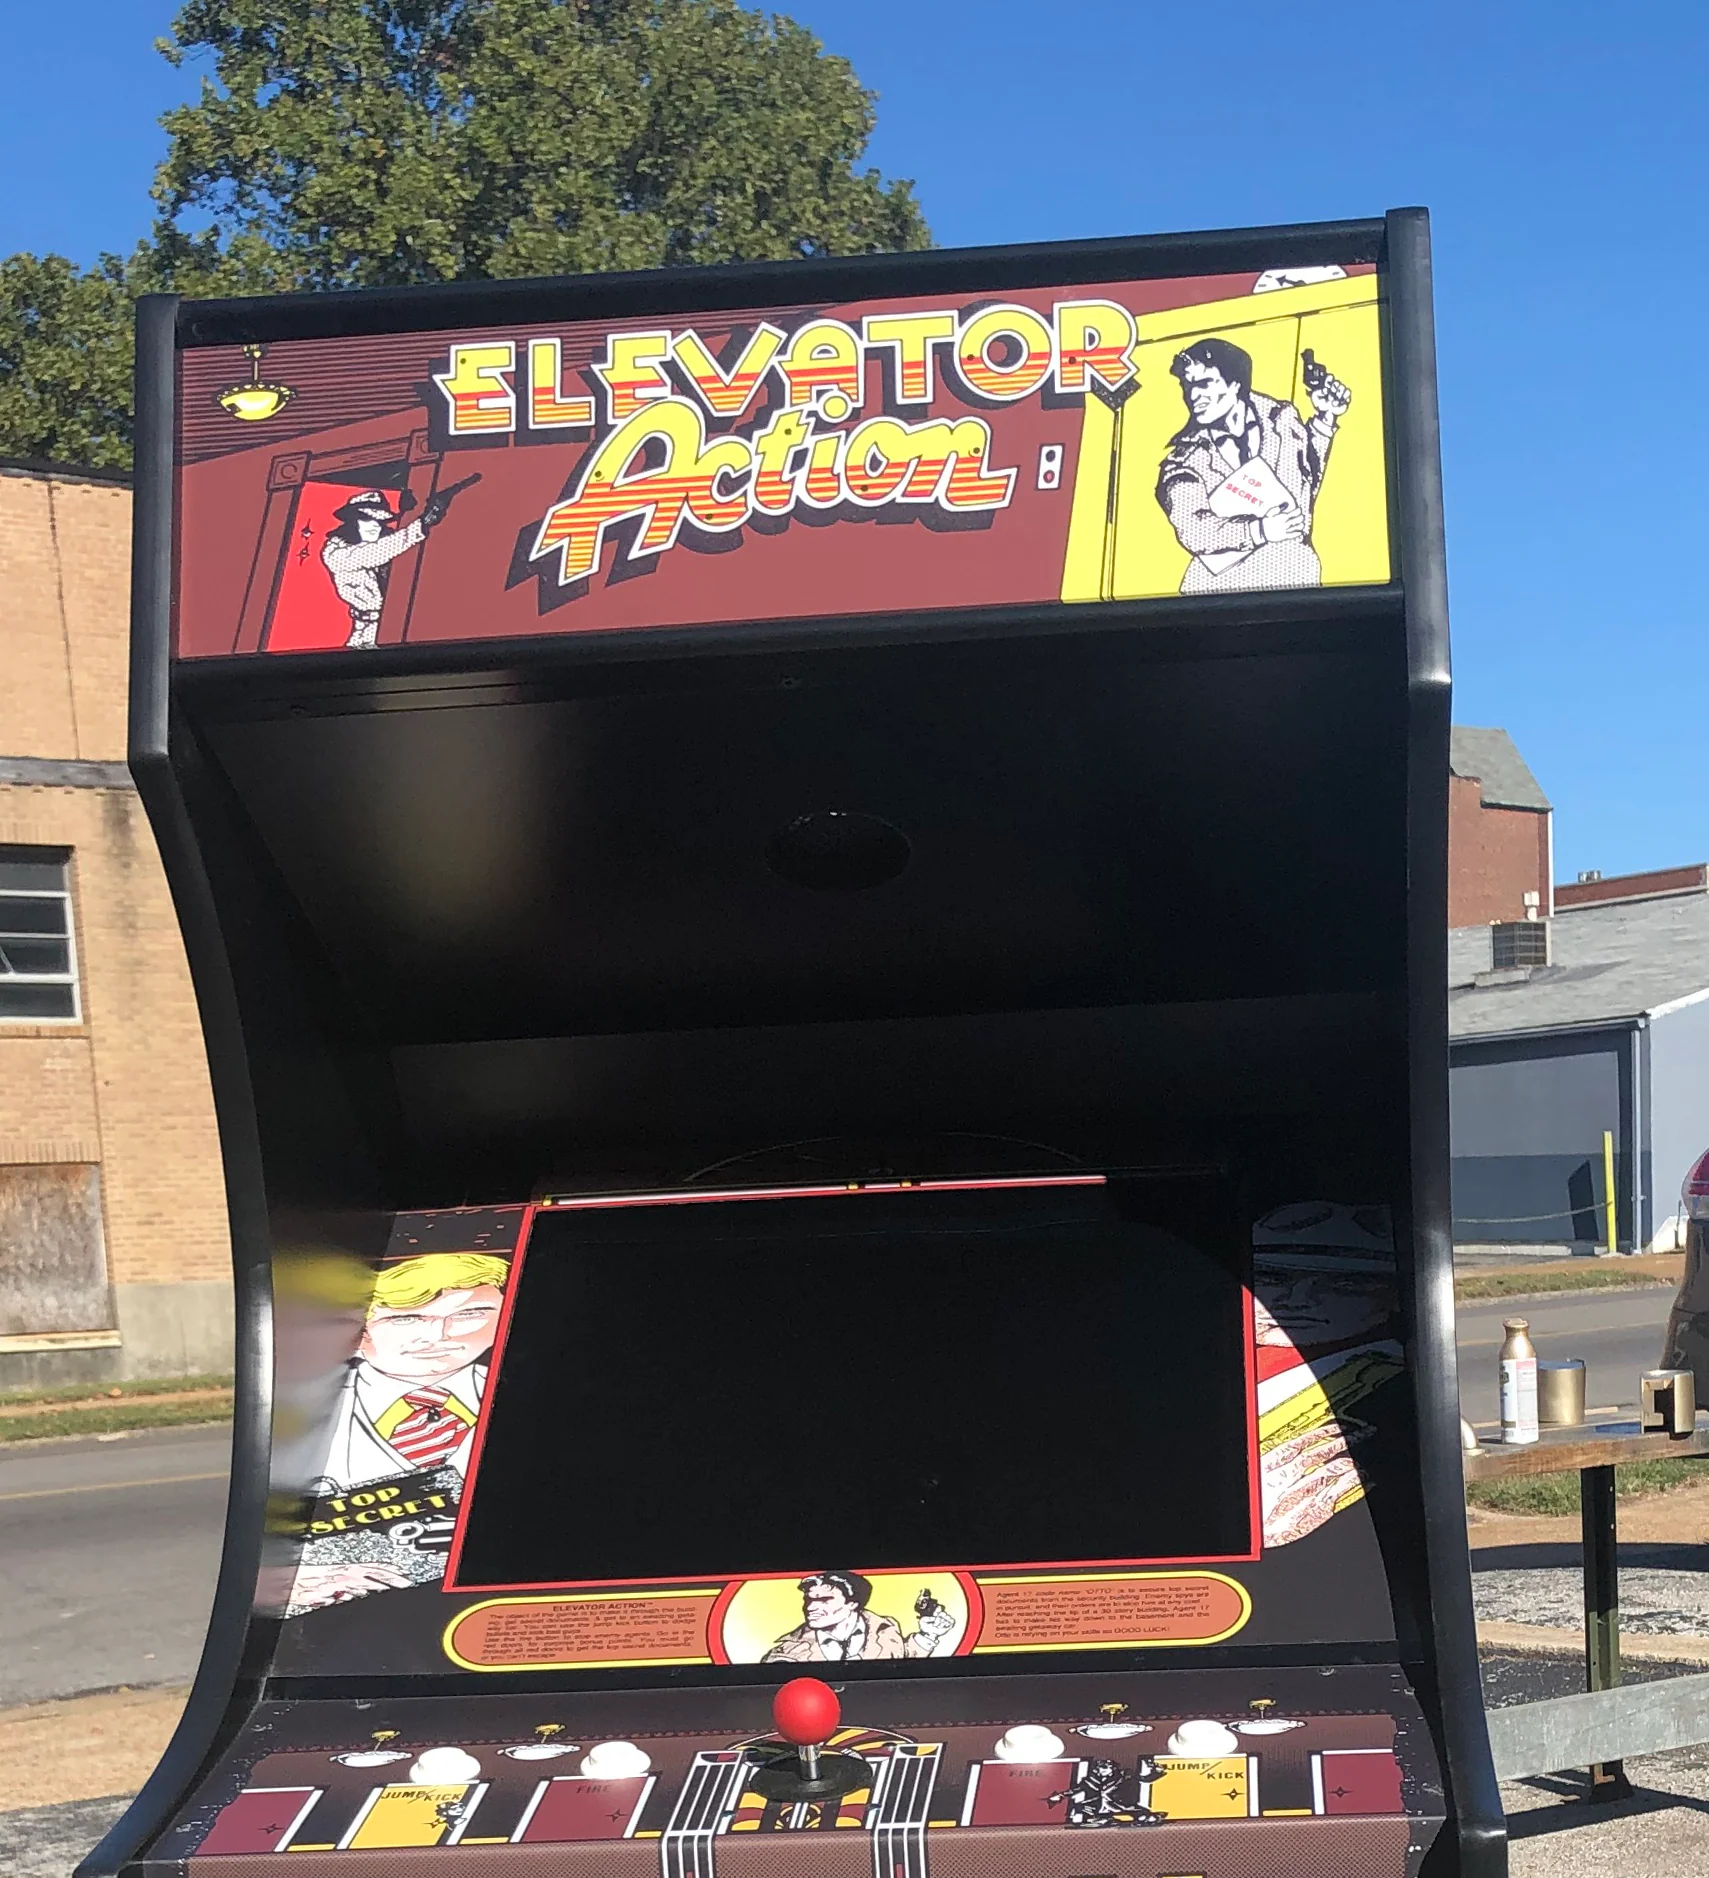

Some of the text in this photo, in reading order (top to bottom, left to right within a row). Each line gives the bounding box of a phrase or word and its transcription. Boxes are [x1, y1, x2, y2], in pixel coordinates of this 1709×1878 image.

[433, 300, 1140, 435] ELEVATOR
[529, 389, 1019, 585] Action
[1242, 474, 1262, 488] TOP
[1225, 483, 1264, 507] SECRET
[326, 1487, 400, 1513] TOP
[311, 1494, 446, 1534] SECRET
[552, 1603, 606, 1611] ELEVATOR
[1008, 1769, 1042, 1778] FIRE
[576, 1784, 612, 1794] FIRE
